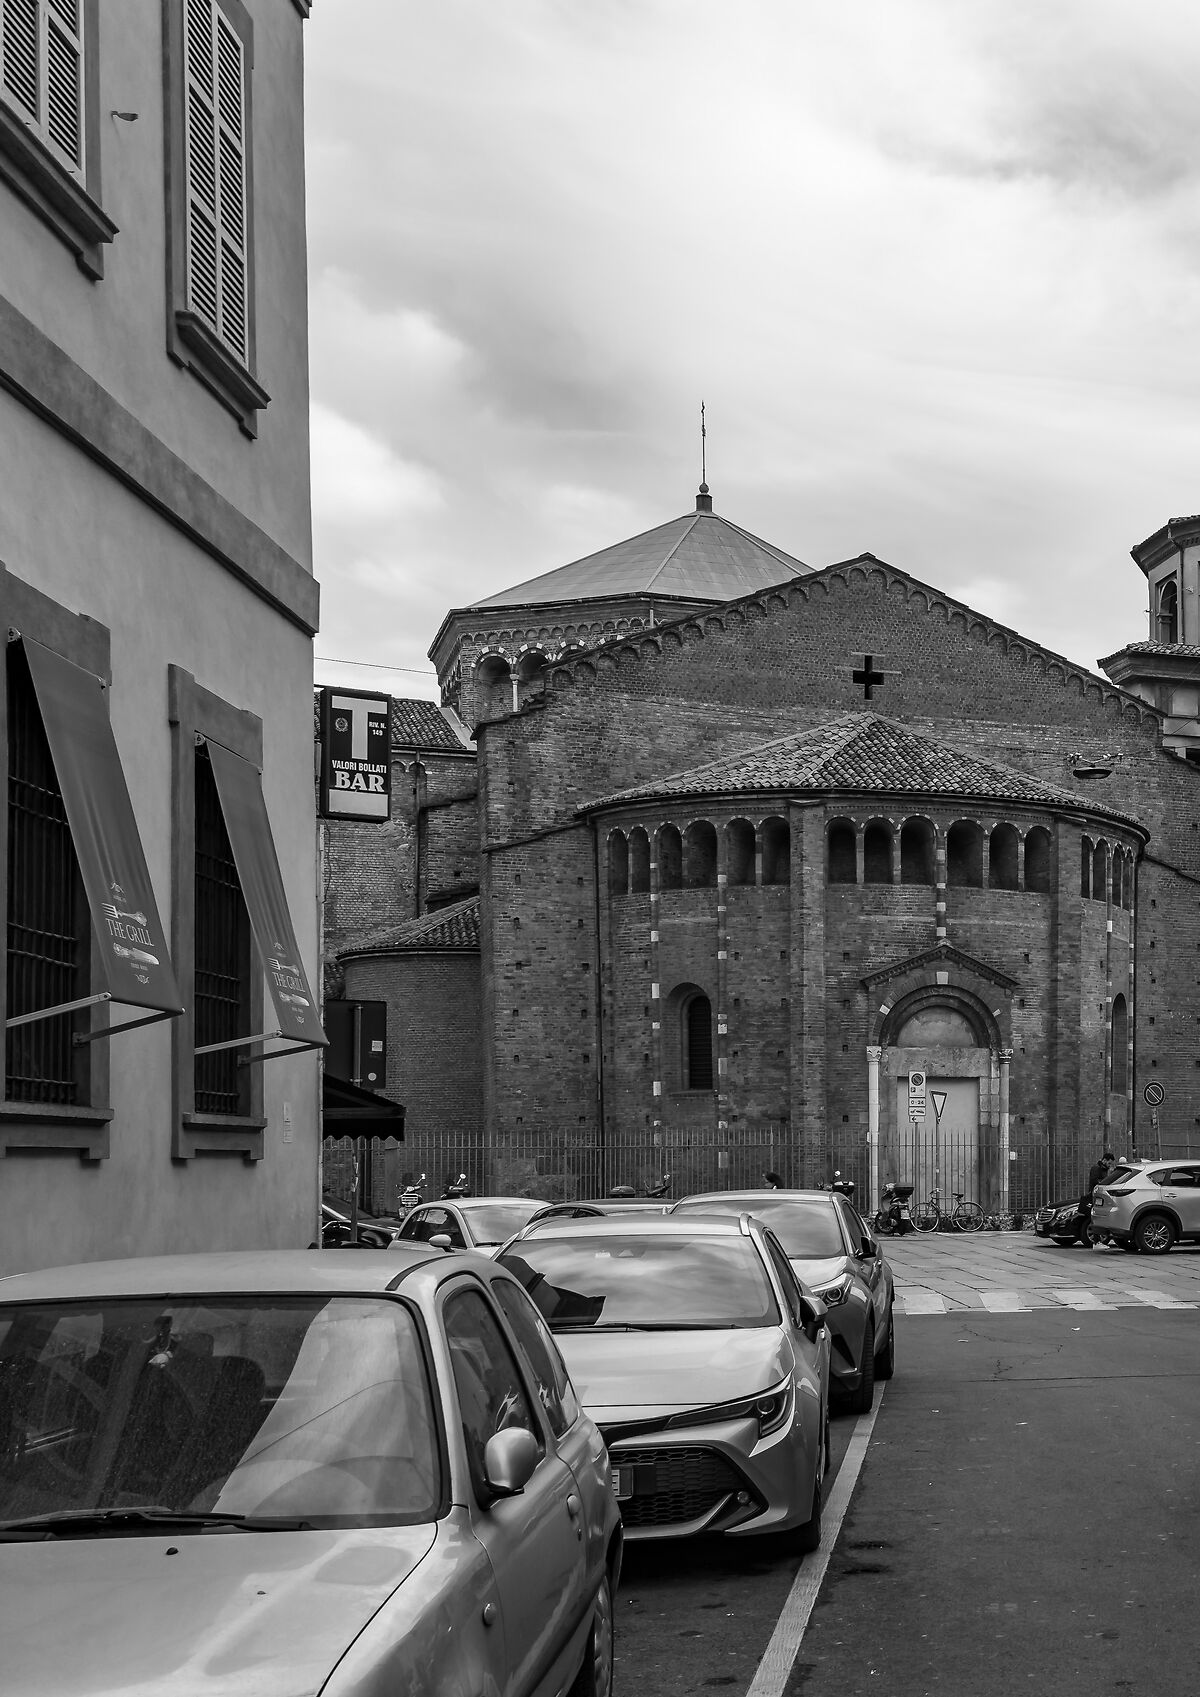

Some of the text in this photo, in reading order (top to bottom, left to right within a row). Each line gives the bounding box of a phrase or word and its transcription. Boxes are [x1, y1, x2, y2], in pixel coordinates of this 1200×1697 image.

[332, 695, 388, 760] T
[331, 759, 387, 774] VALORI BOLLATI
[334, 771, 385, 792] BAR
[105, 918, 155, 947] THE GRILL
[271, 971, 306, 993] THE GRILL
